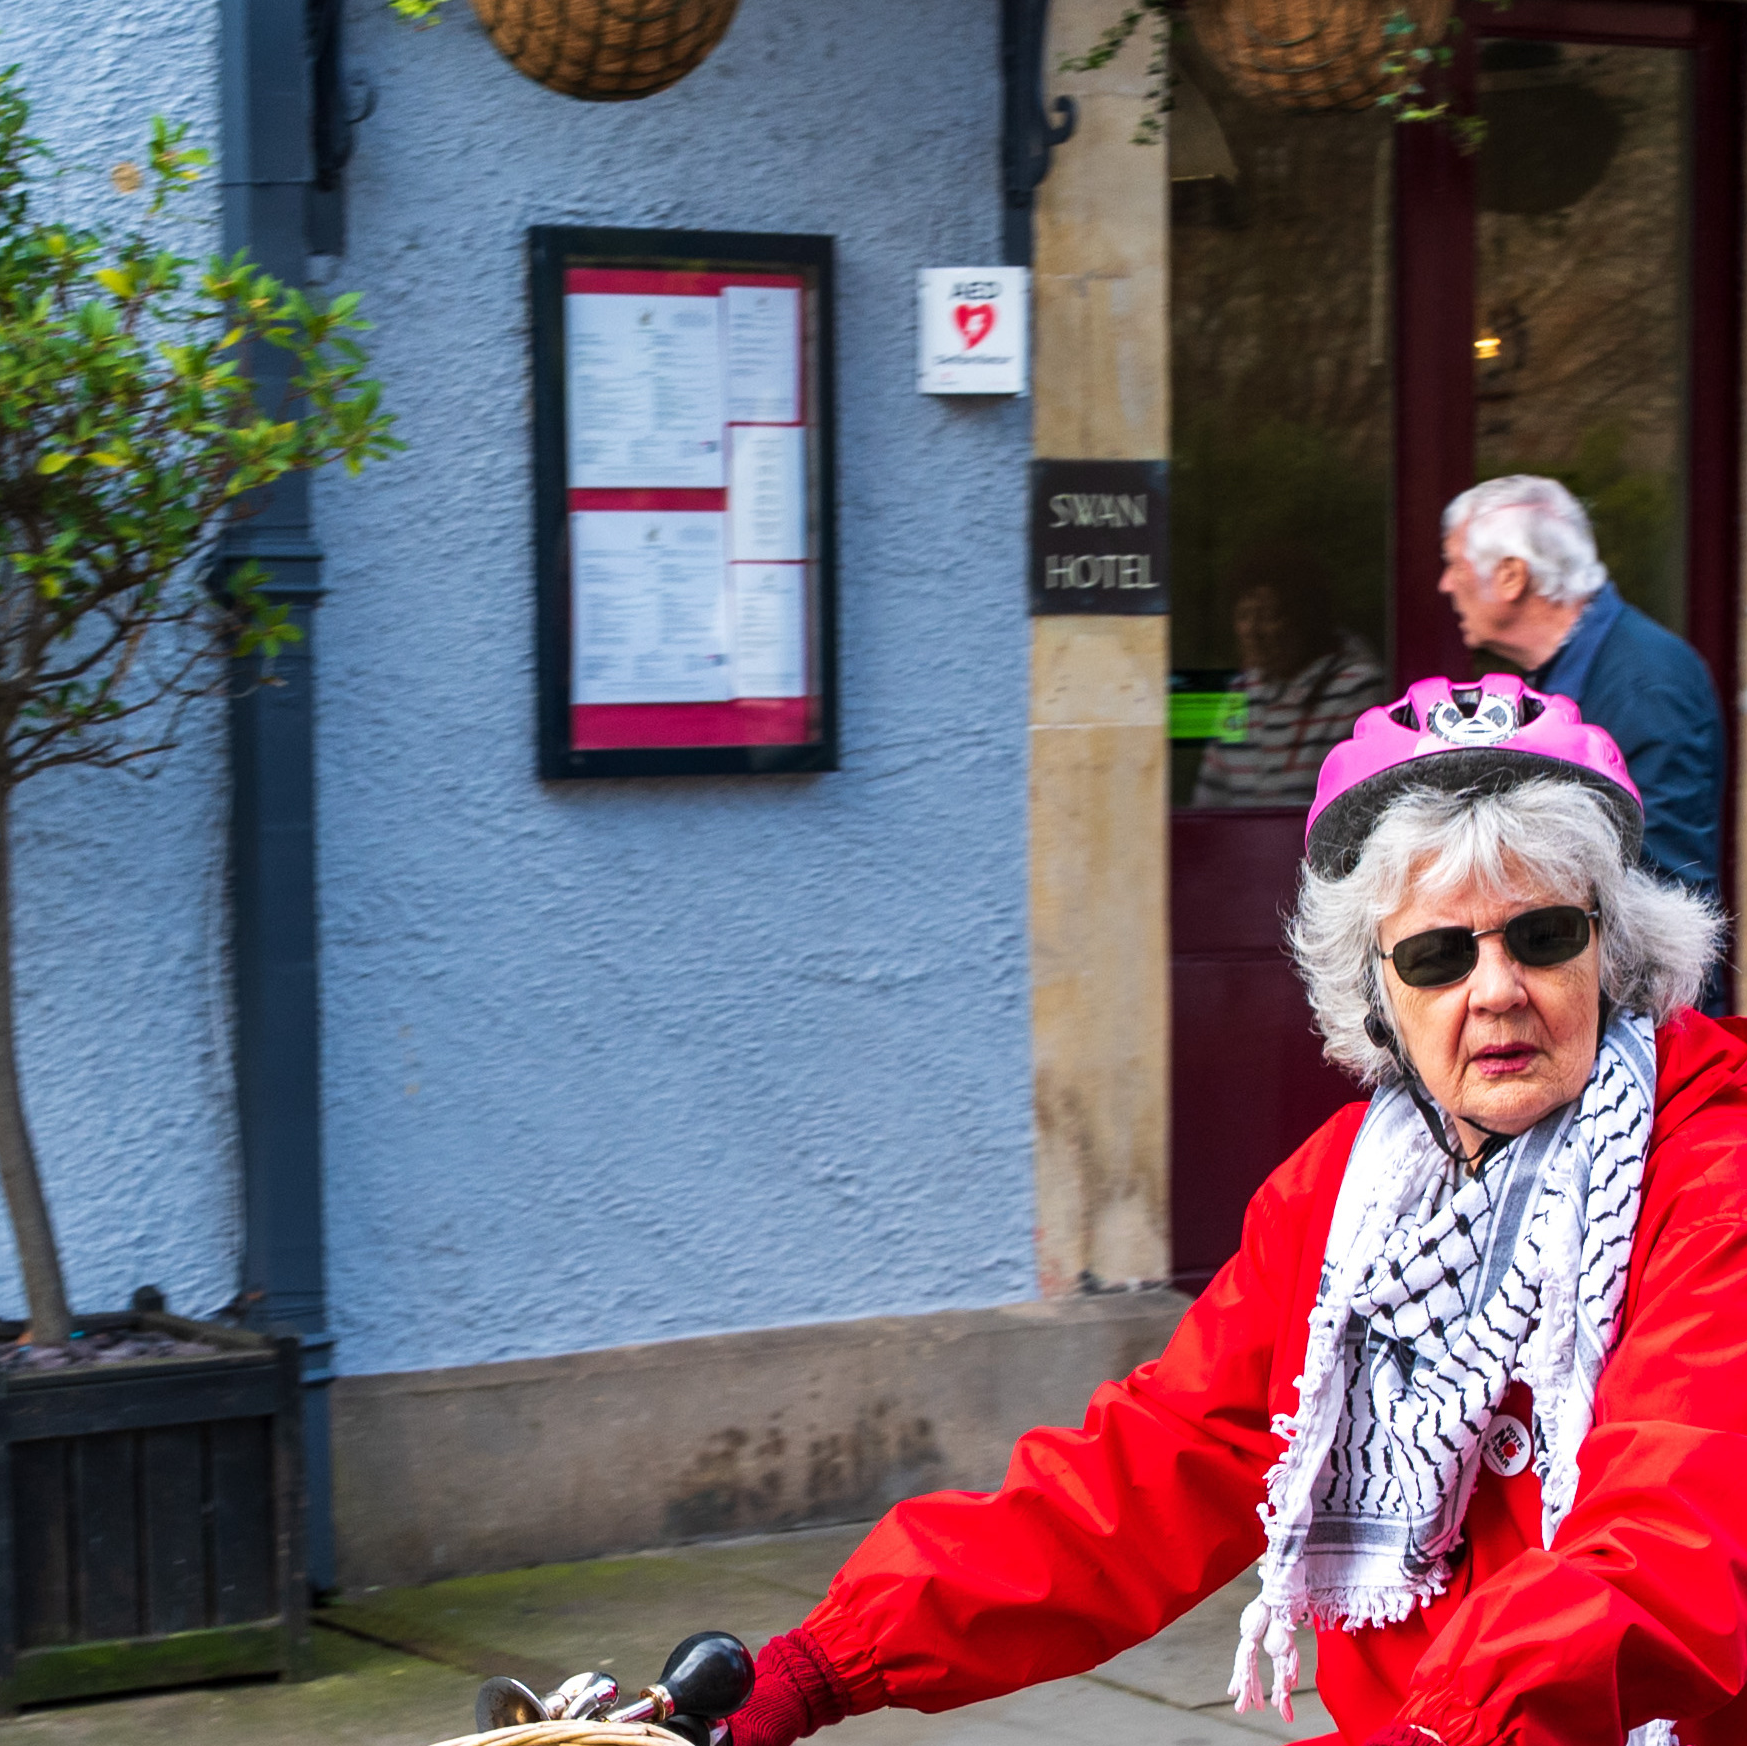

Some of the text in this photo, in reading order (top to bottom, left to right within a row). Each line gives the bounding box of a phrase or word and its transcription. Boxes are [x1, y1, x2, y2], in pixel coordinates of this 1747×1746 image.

[949, 281, 1003, 300] AED
[1049, 493, 1147, 528] SWAN
[1045, 554, 1159, 589] HOTEL
[1505, 1423, 1525, 1451] VOTE
[1493, 1444, 1510, 1469] WAR
